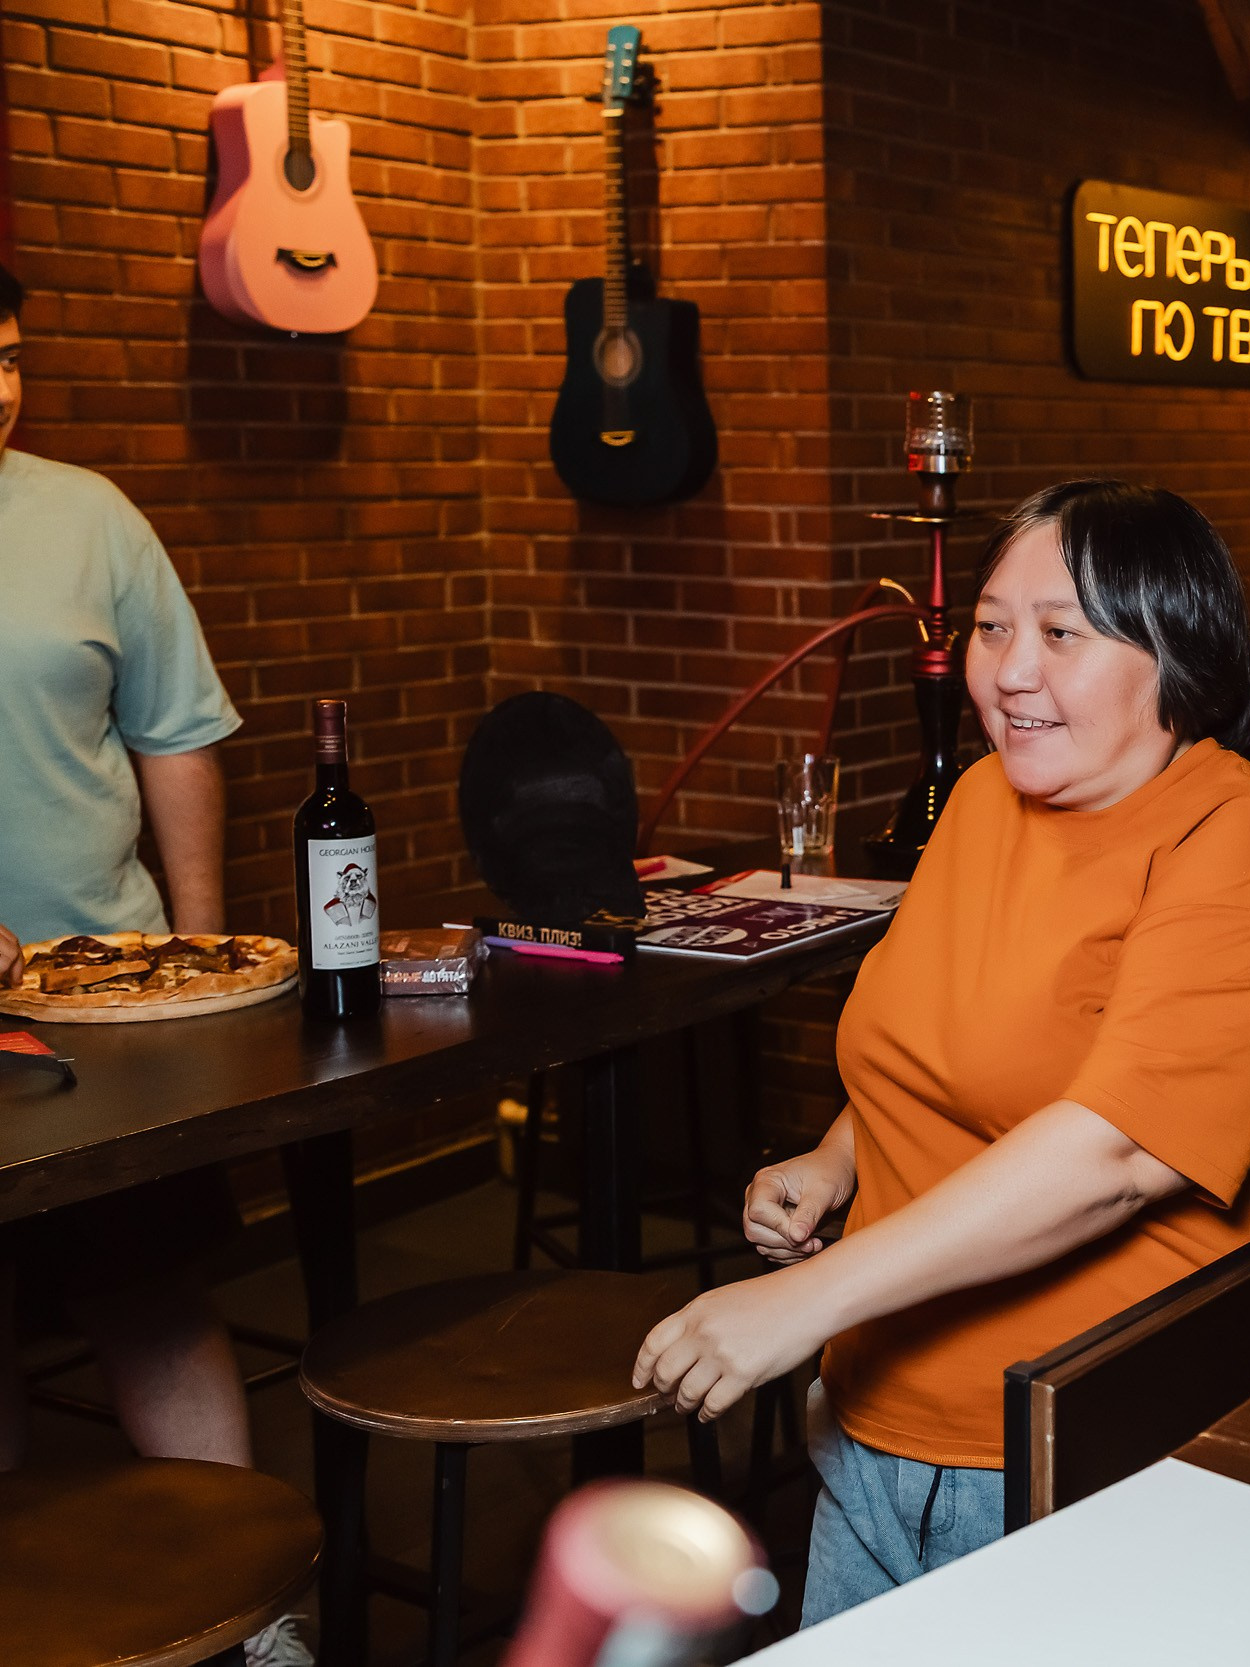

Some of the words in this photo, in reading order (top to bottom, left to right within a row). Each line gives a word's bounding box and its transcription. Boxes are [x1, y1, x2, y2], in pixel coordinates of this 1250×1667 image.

[1131, 299, 1195, 361] ПО
[319, 847, 359, 857] GEORGIAN
[498, 922, 537, 942] КВИЗ,
[539, 927, 582, 947] ПЛИЗ!
